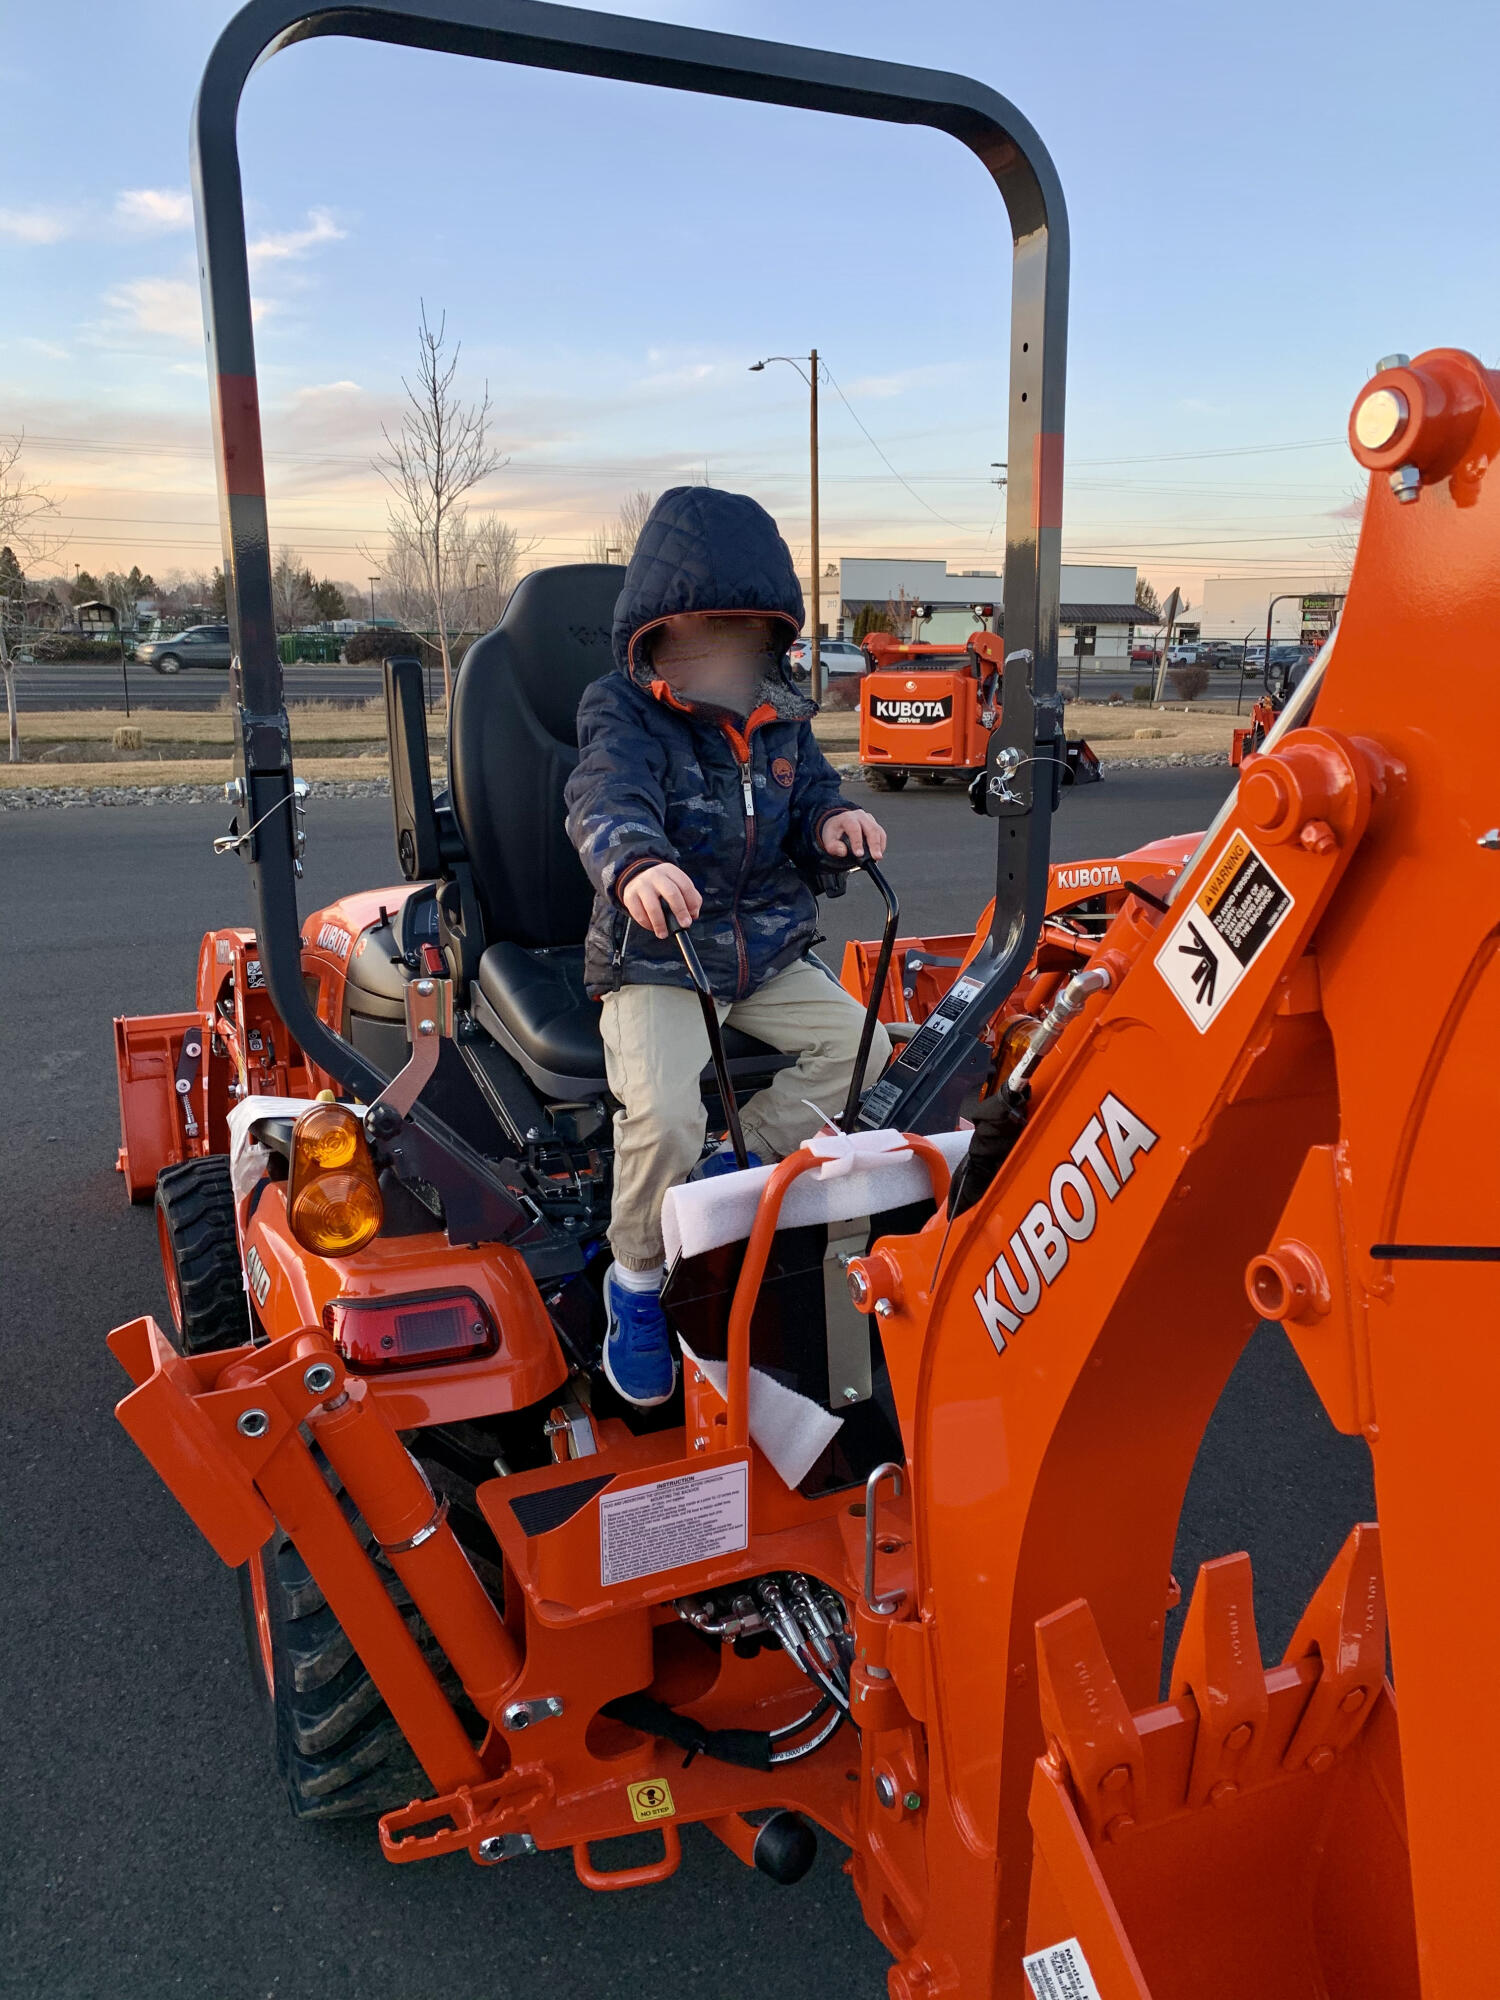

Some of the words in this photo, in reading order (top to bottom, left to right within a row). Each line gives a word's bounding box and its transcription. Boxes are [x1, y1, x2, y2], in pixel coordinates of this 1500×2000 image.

[876, 701, 945, 717] KUBOTA
[1058, 866, 1122, 889] KUBOTA
[1209, 844, 1245, 897] WARNING
[1213, 914, 1223, 927] TO
[1220, 895, 1236, 917] AVOID
[1233, 859, 1259, 897] PERSONAL
[1223, 916, 1238, 936] STAY
[1235, 894, 1253, 918] CLEAR
[1250, 882, 1260, 897] OF
[1229, 902, 1257, 942] OPERATING
[1252, 884, 1269, 905] AREA
[1239, 921, 1252, 938] THE
[316, 922, 352, 960] KUBOTA
[973, 1091, 1160, 1356] KUBOTA
[656, 1475, 694, 1489] INSTRUCTION
[652, 1806, 670, 1815] STEP
[1052, 1951, 1065, 1974] S/N
[1064, 1948, 1085, 1989] Model
